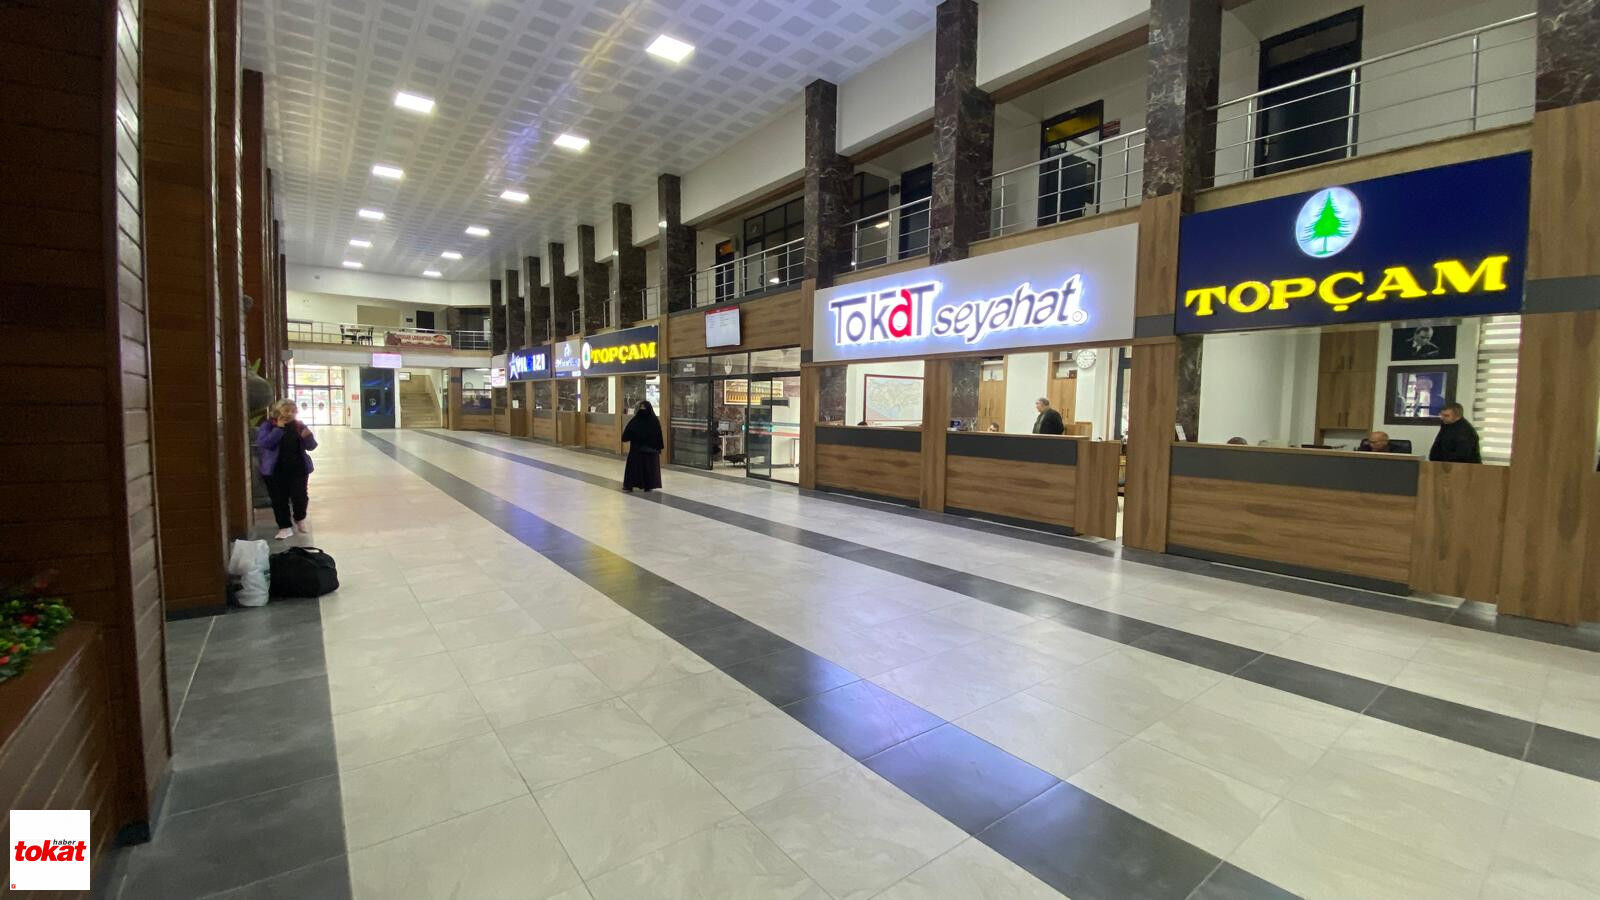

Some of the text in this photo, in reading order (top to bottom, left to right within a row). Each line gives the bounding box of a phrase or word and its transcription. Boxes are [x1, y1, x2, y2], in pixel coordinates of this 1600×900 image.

[934, 279, 1076, 343] seyahat
[1185, 256, 1508, 316] TOPÇAM
[591, 342, 656, 364] TOPÇAM
